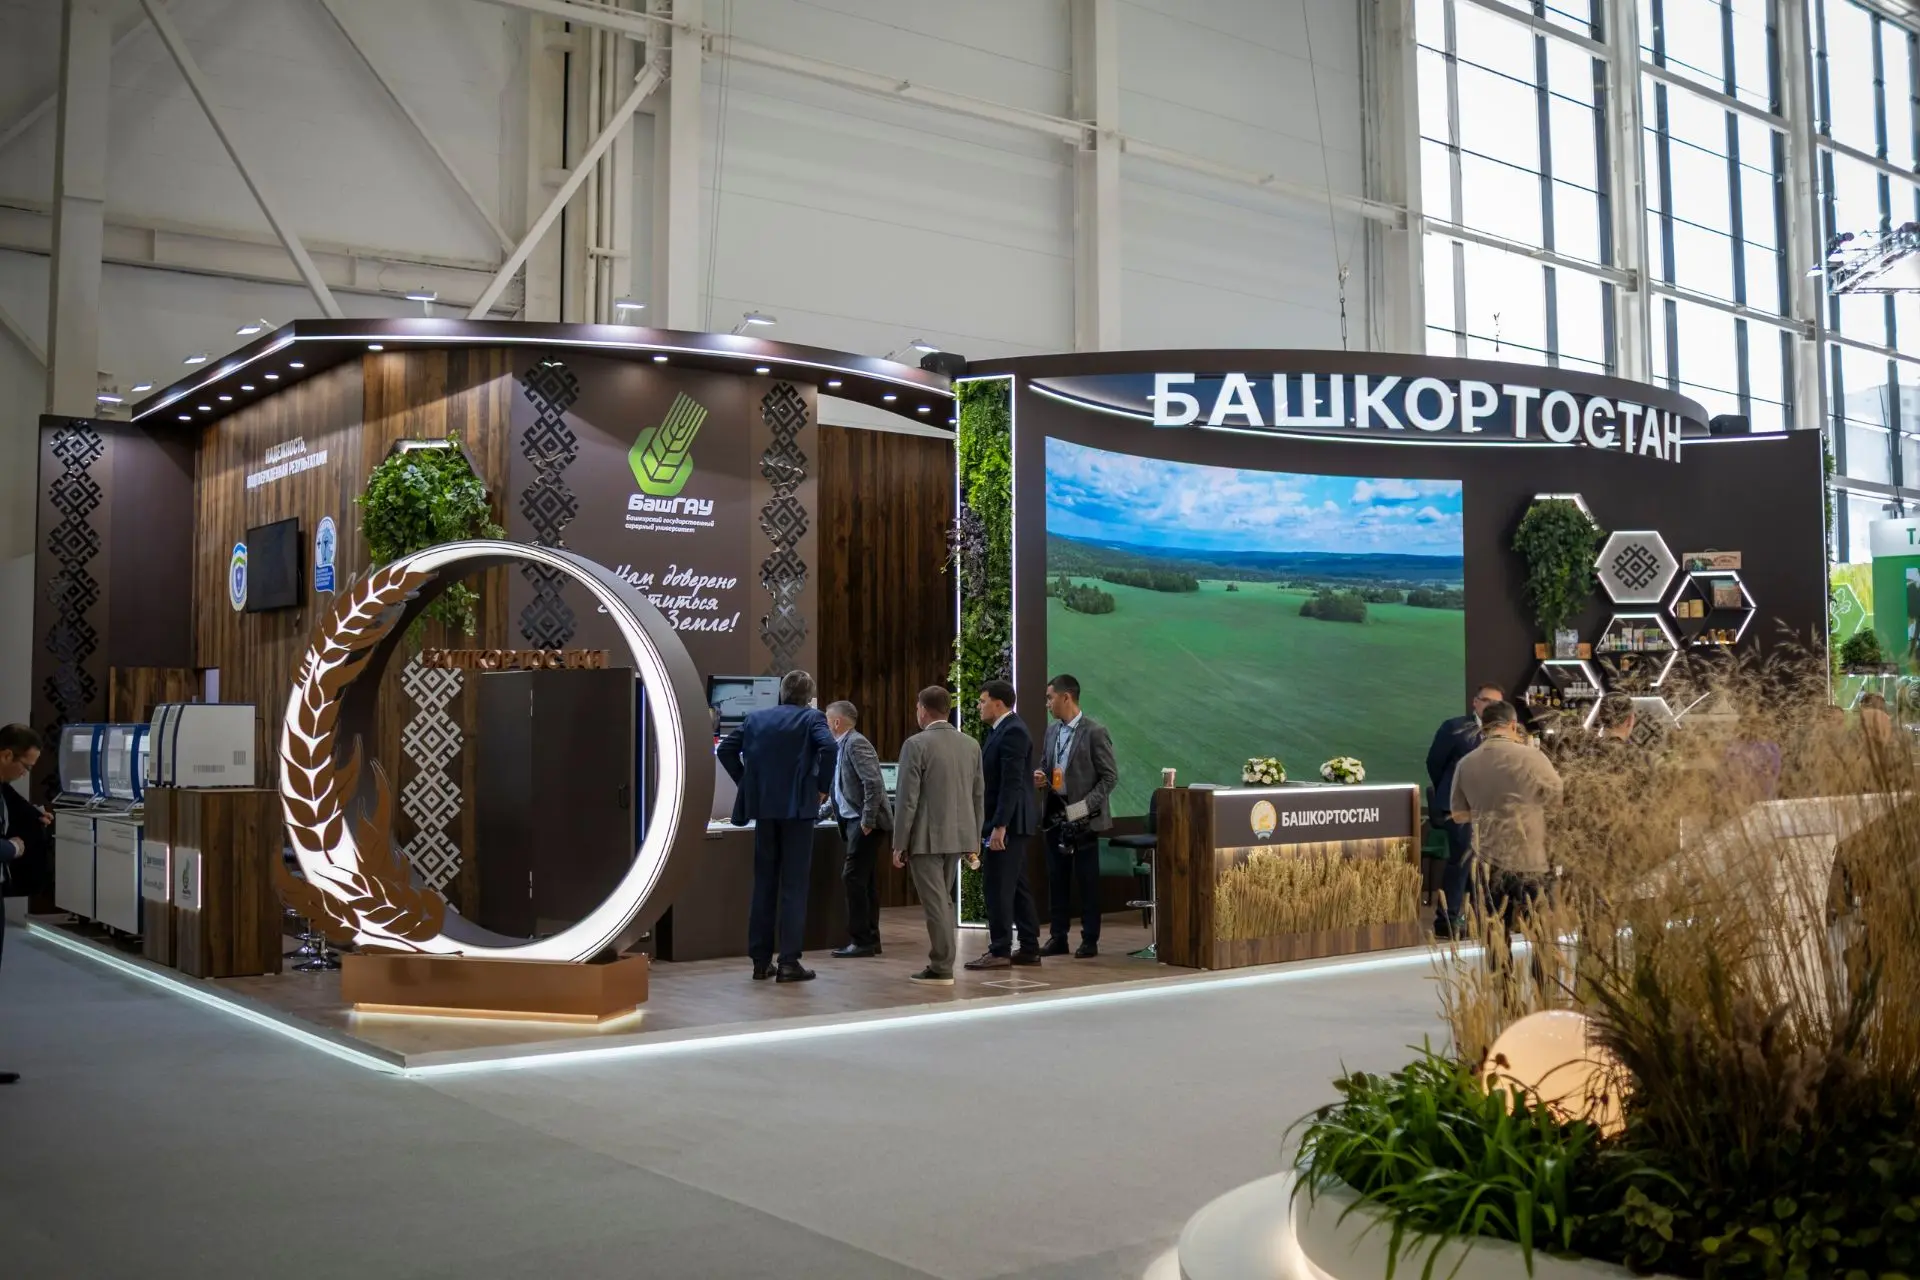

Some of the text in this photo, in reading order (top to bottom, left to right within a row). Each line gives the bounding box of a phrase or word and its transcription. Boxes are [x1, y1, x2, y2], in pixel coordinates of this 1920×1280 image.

[1153, 372, 1682, 463] БАШКОРТОСТАН
[628, 494, 714, 516] БашГАУ
[662, 564, 737, 597] доверено
[636, 585, 718, 610] титься
[668, 609, 740, 632] Земле!
[1282, 808, 1379, 827] БАШКОРТОСТАН
